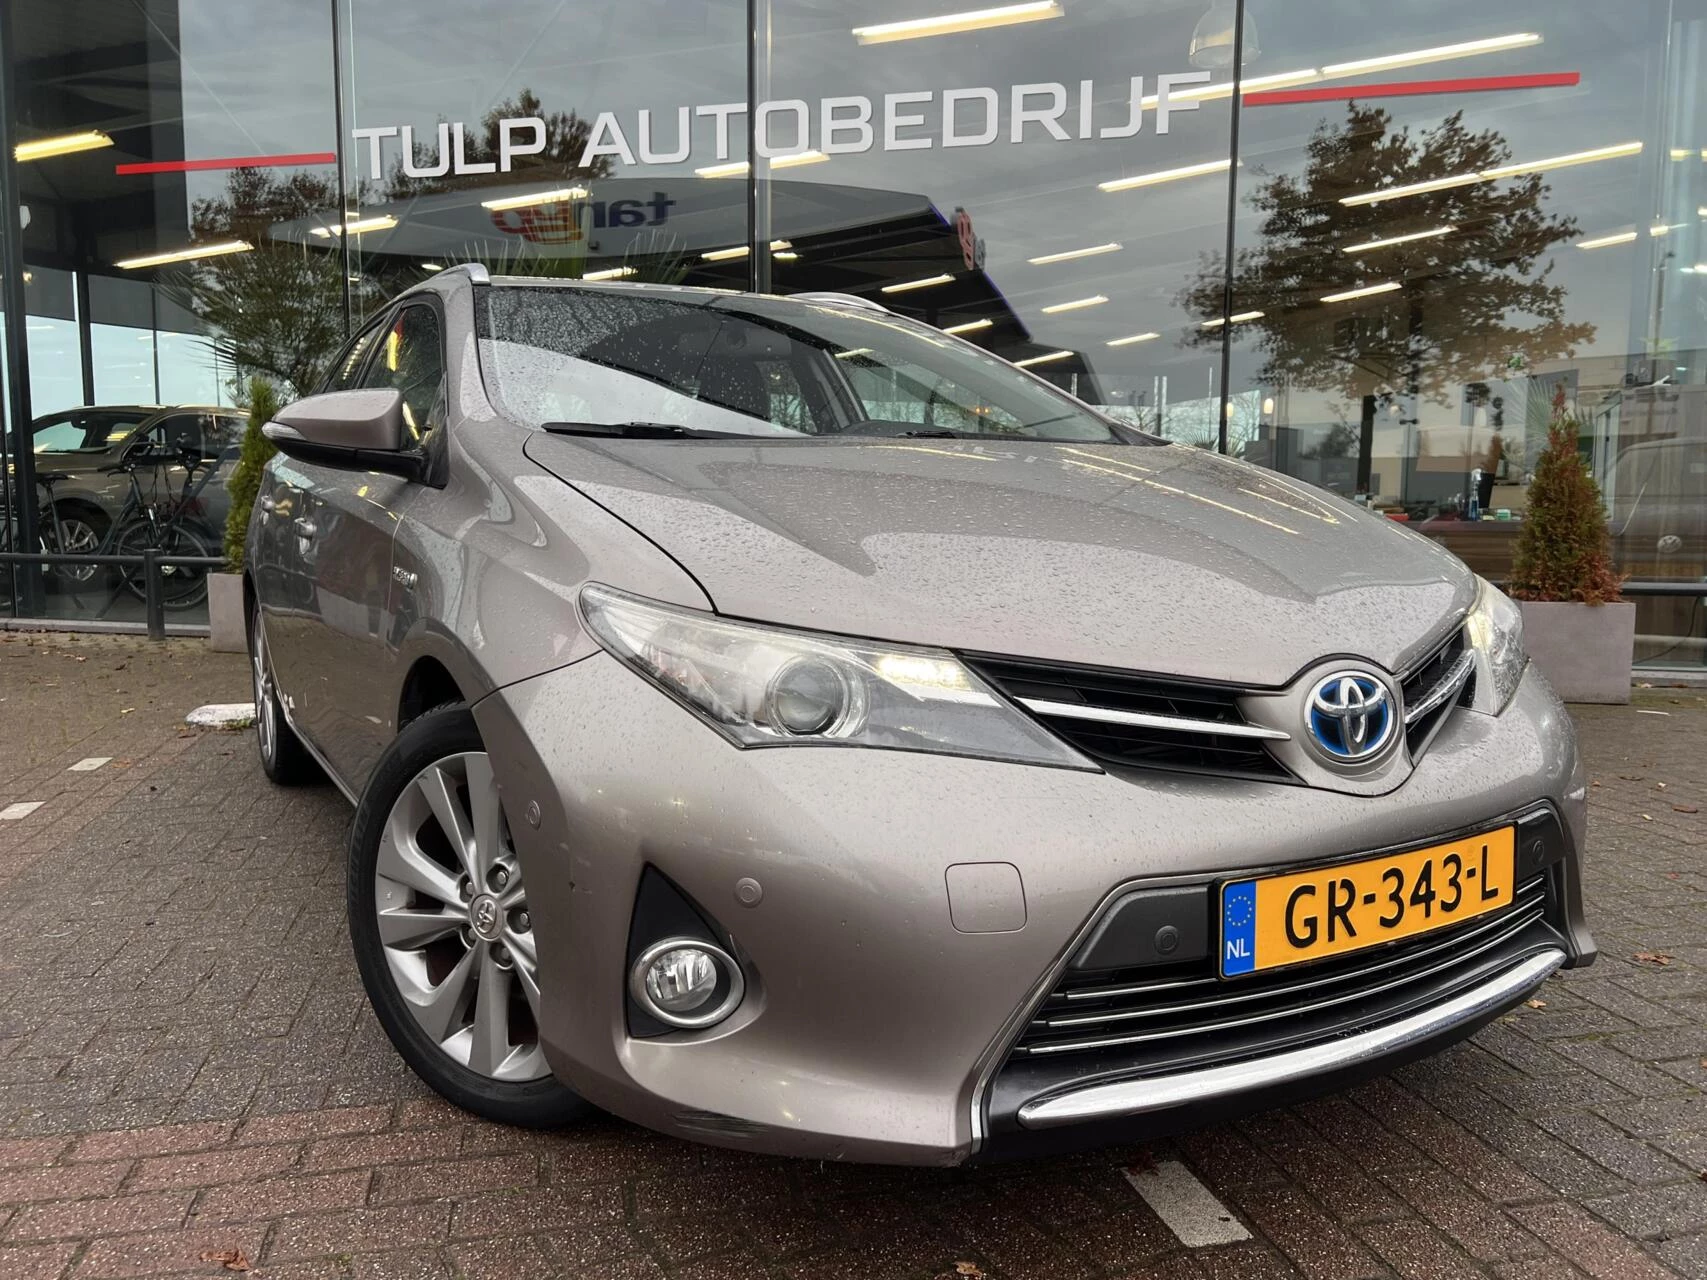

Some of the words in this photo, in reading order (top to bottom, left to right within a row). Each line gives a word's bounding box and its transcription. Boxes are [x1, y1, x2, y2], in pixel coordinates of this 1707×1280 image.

[352, 116, 547, 180] TULP
[578, 71, 1212, 168] AUTOBEDRIJF
[1226, 938, 1250, 960] NL
[1285, 844, 1500, 949] GR-343-L
